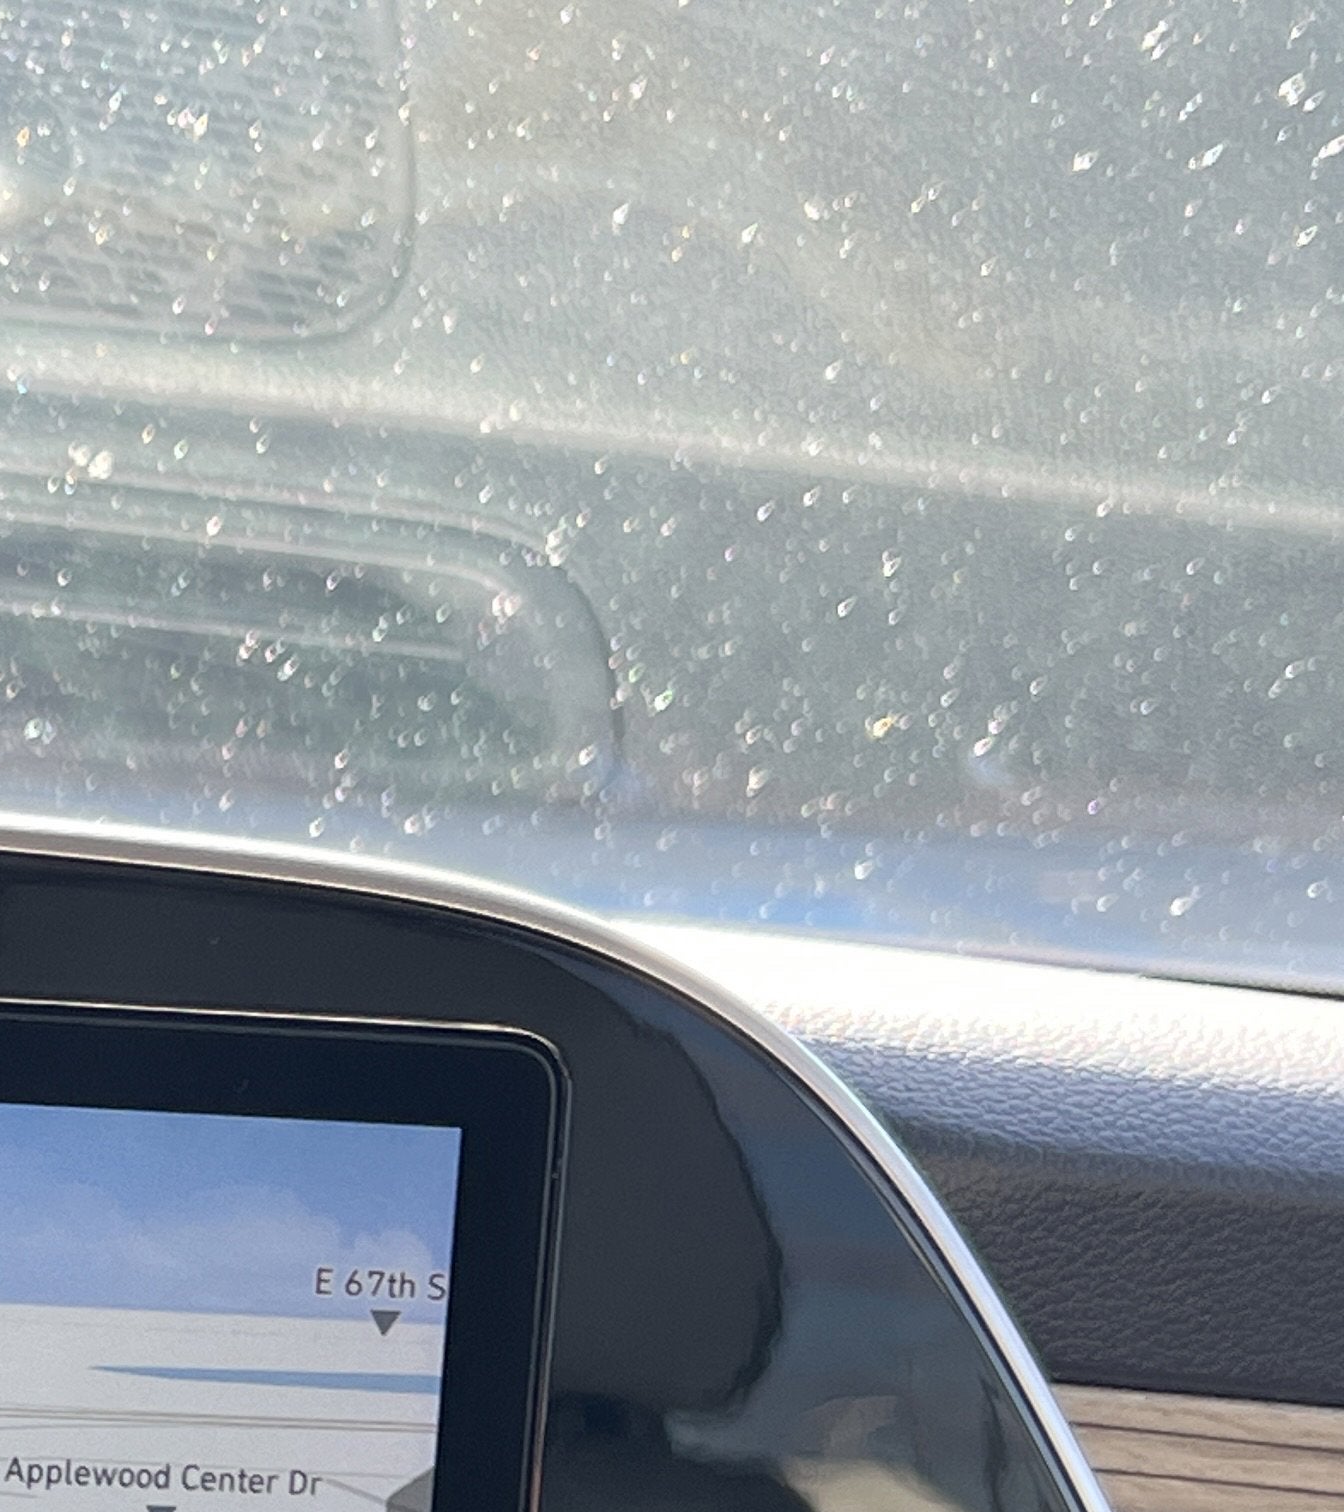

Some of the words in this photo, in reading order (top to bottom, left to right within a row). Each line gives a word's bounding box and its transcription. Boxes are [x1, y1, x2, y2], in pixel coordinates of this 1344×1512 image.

[315, 1268, 334, 1295] E
[344, 1269, 416, 1299] 67th
[427, 1273, 447, 1301] S
[4, 1456, 170, 1490] Applewood
[181, 1463, 279, 1494] Center
[289, 1470, 323, 1497] Dr
